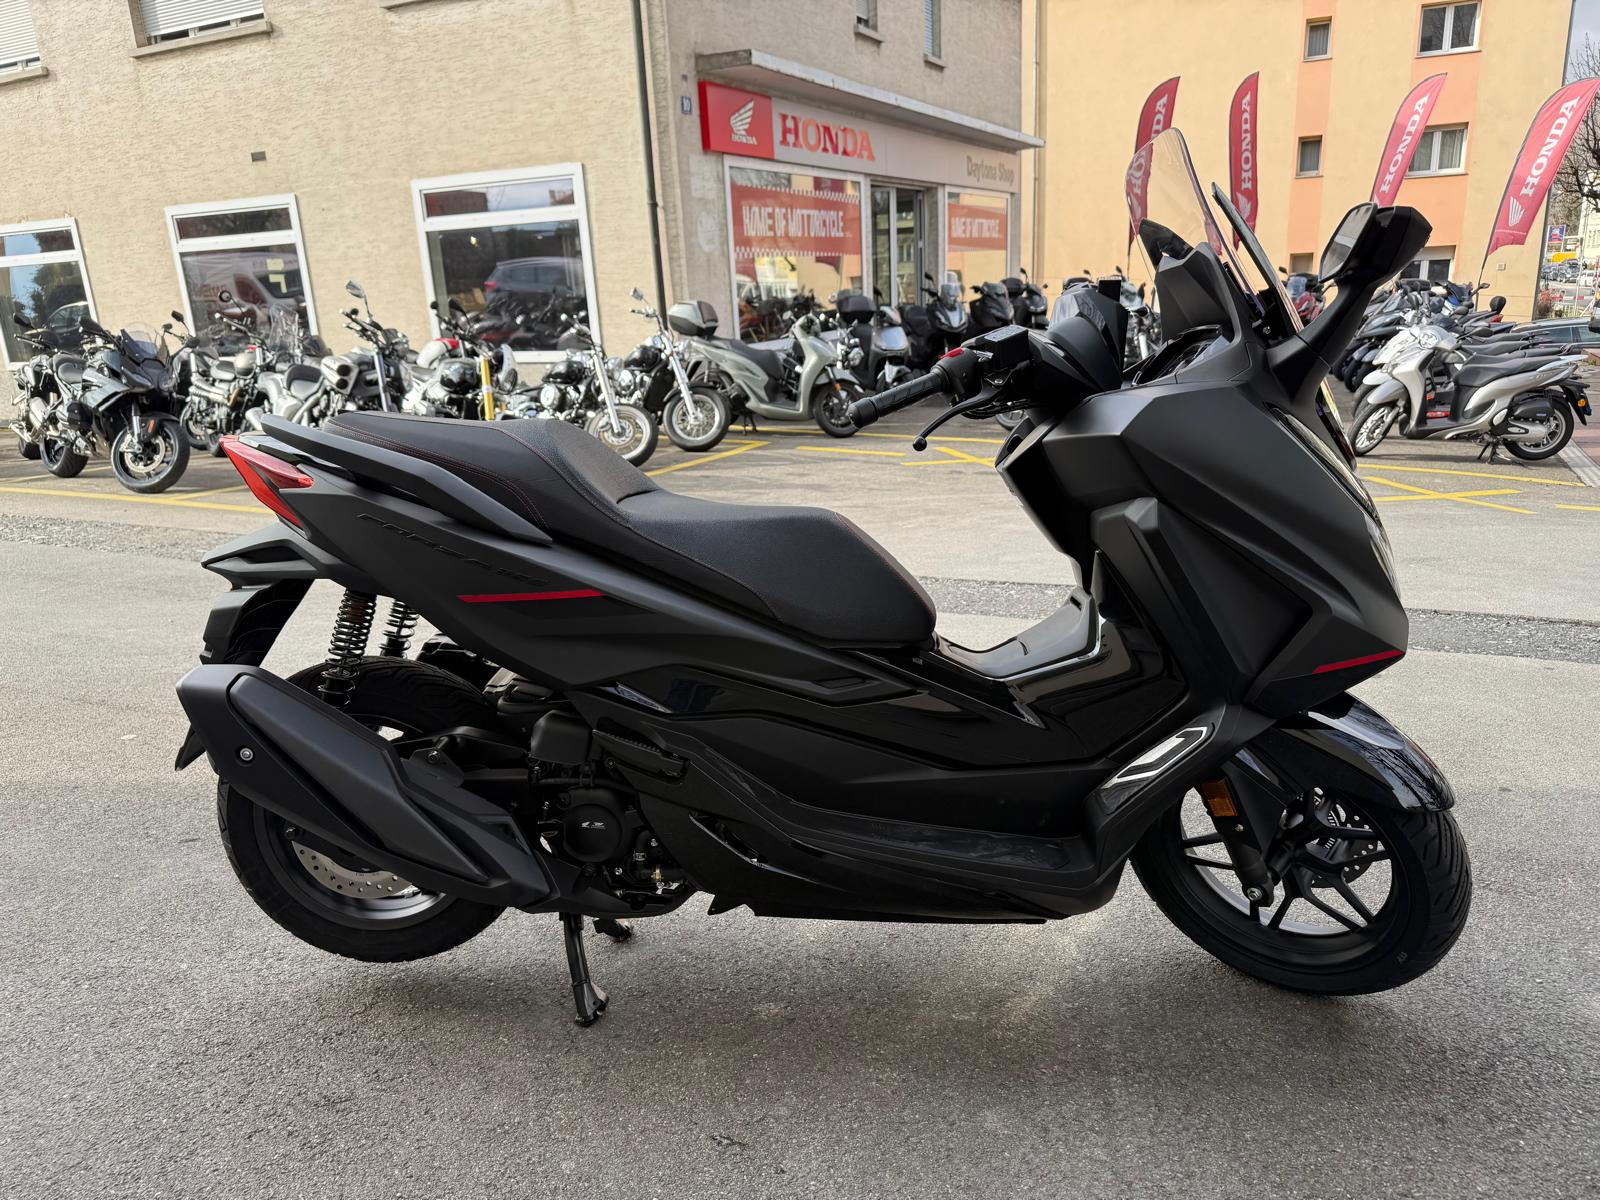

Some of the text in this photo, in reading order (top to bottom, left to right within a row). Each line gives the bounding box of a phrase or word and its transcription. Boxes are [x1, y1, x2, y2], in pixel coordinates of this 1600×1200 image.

[731, 133, 758, 145] HONDA
[778, 112, 876, 161] HONDA
[1241, 90, 1253, 190] HONDA
[1380, 93, 1430, 193] HONDA
[1519, 96, 1581, 197] HONDA
[966, 154, 1016, 187] Daytona Shop
[775, 207, 787, 238] OF
